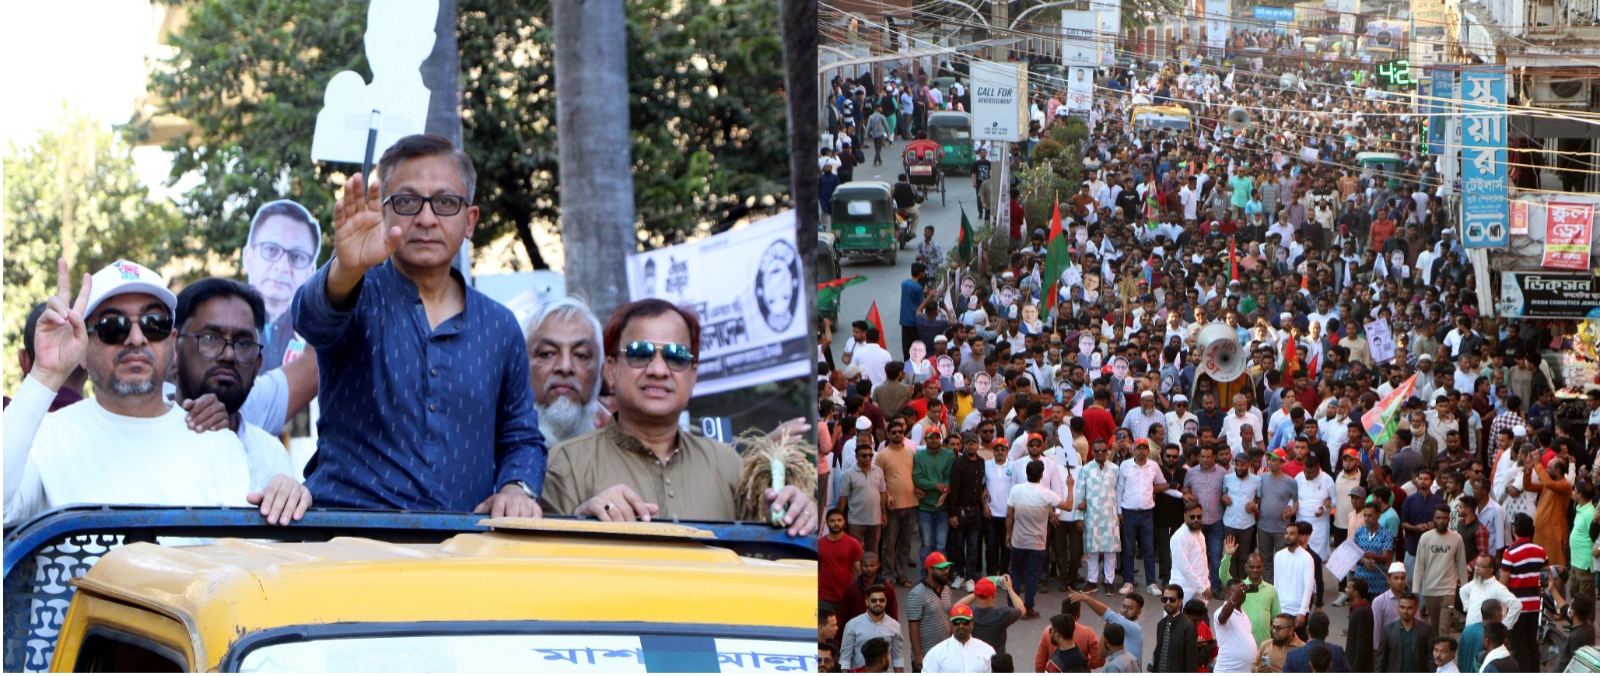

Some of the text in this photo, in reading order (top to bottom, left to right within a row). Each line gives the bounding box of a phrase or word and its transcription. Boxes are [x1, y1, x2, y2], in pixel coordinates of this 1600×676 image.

[977, 86, 1013, 98] CALL FOR
[1551, 205, 1590, 224] স্কুল
[1552, 223, 1586, 238] ড্রেস
[1430, 544, 1451, 554] GAP
